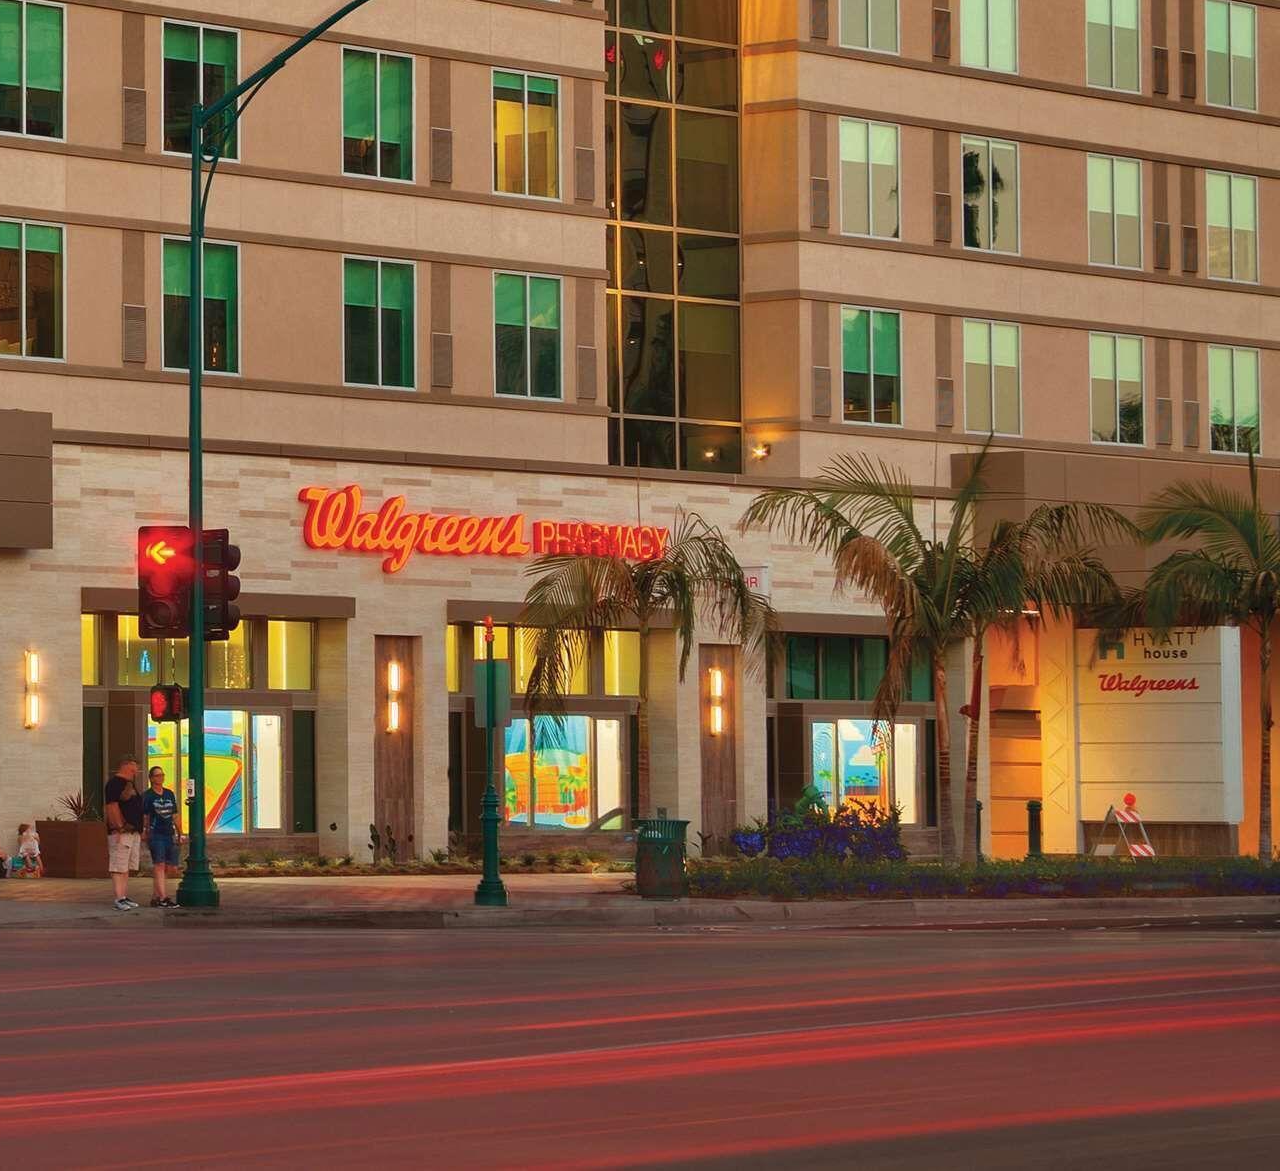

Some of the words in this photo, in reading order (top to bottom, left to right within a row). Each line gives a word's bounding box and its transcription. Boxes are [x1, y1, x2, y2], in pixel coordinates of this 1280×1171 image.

[298, 484, 531, 574] Walgreens
[1133, 631, 1197, 647] HYATT
[1143, 648, 1188, 659] house
[1098, 673, 1200, 697] Walgreens
